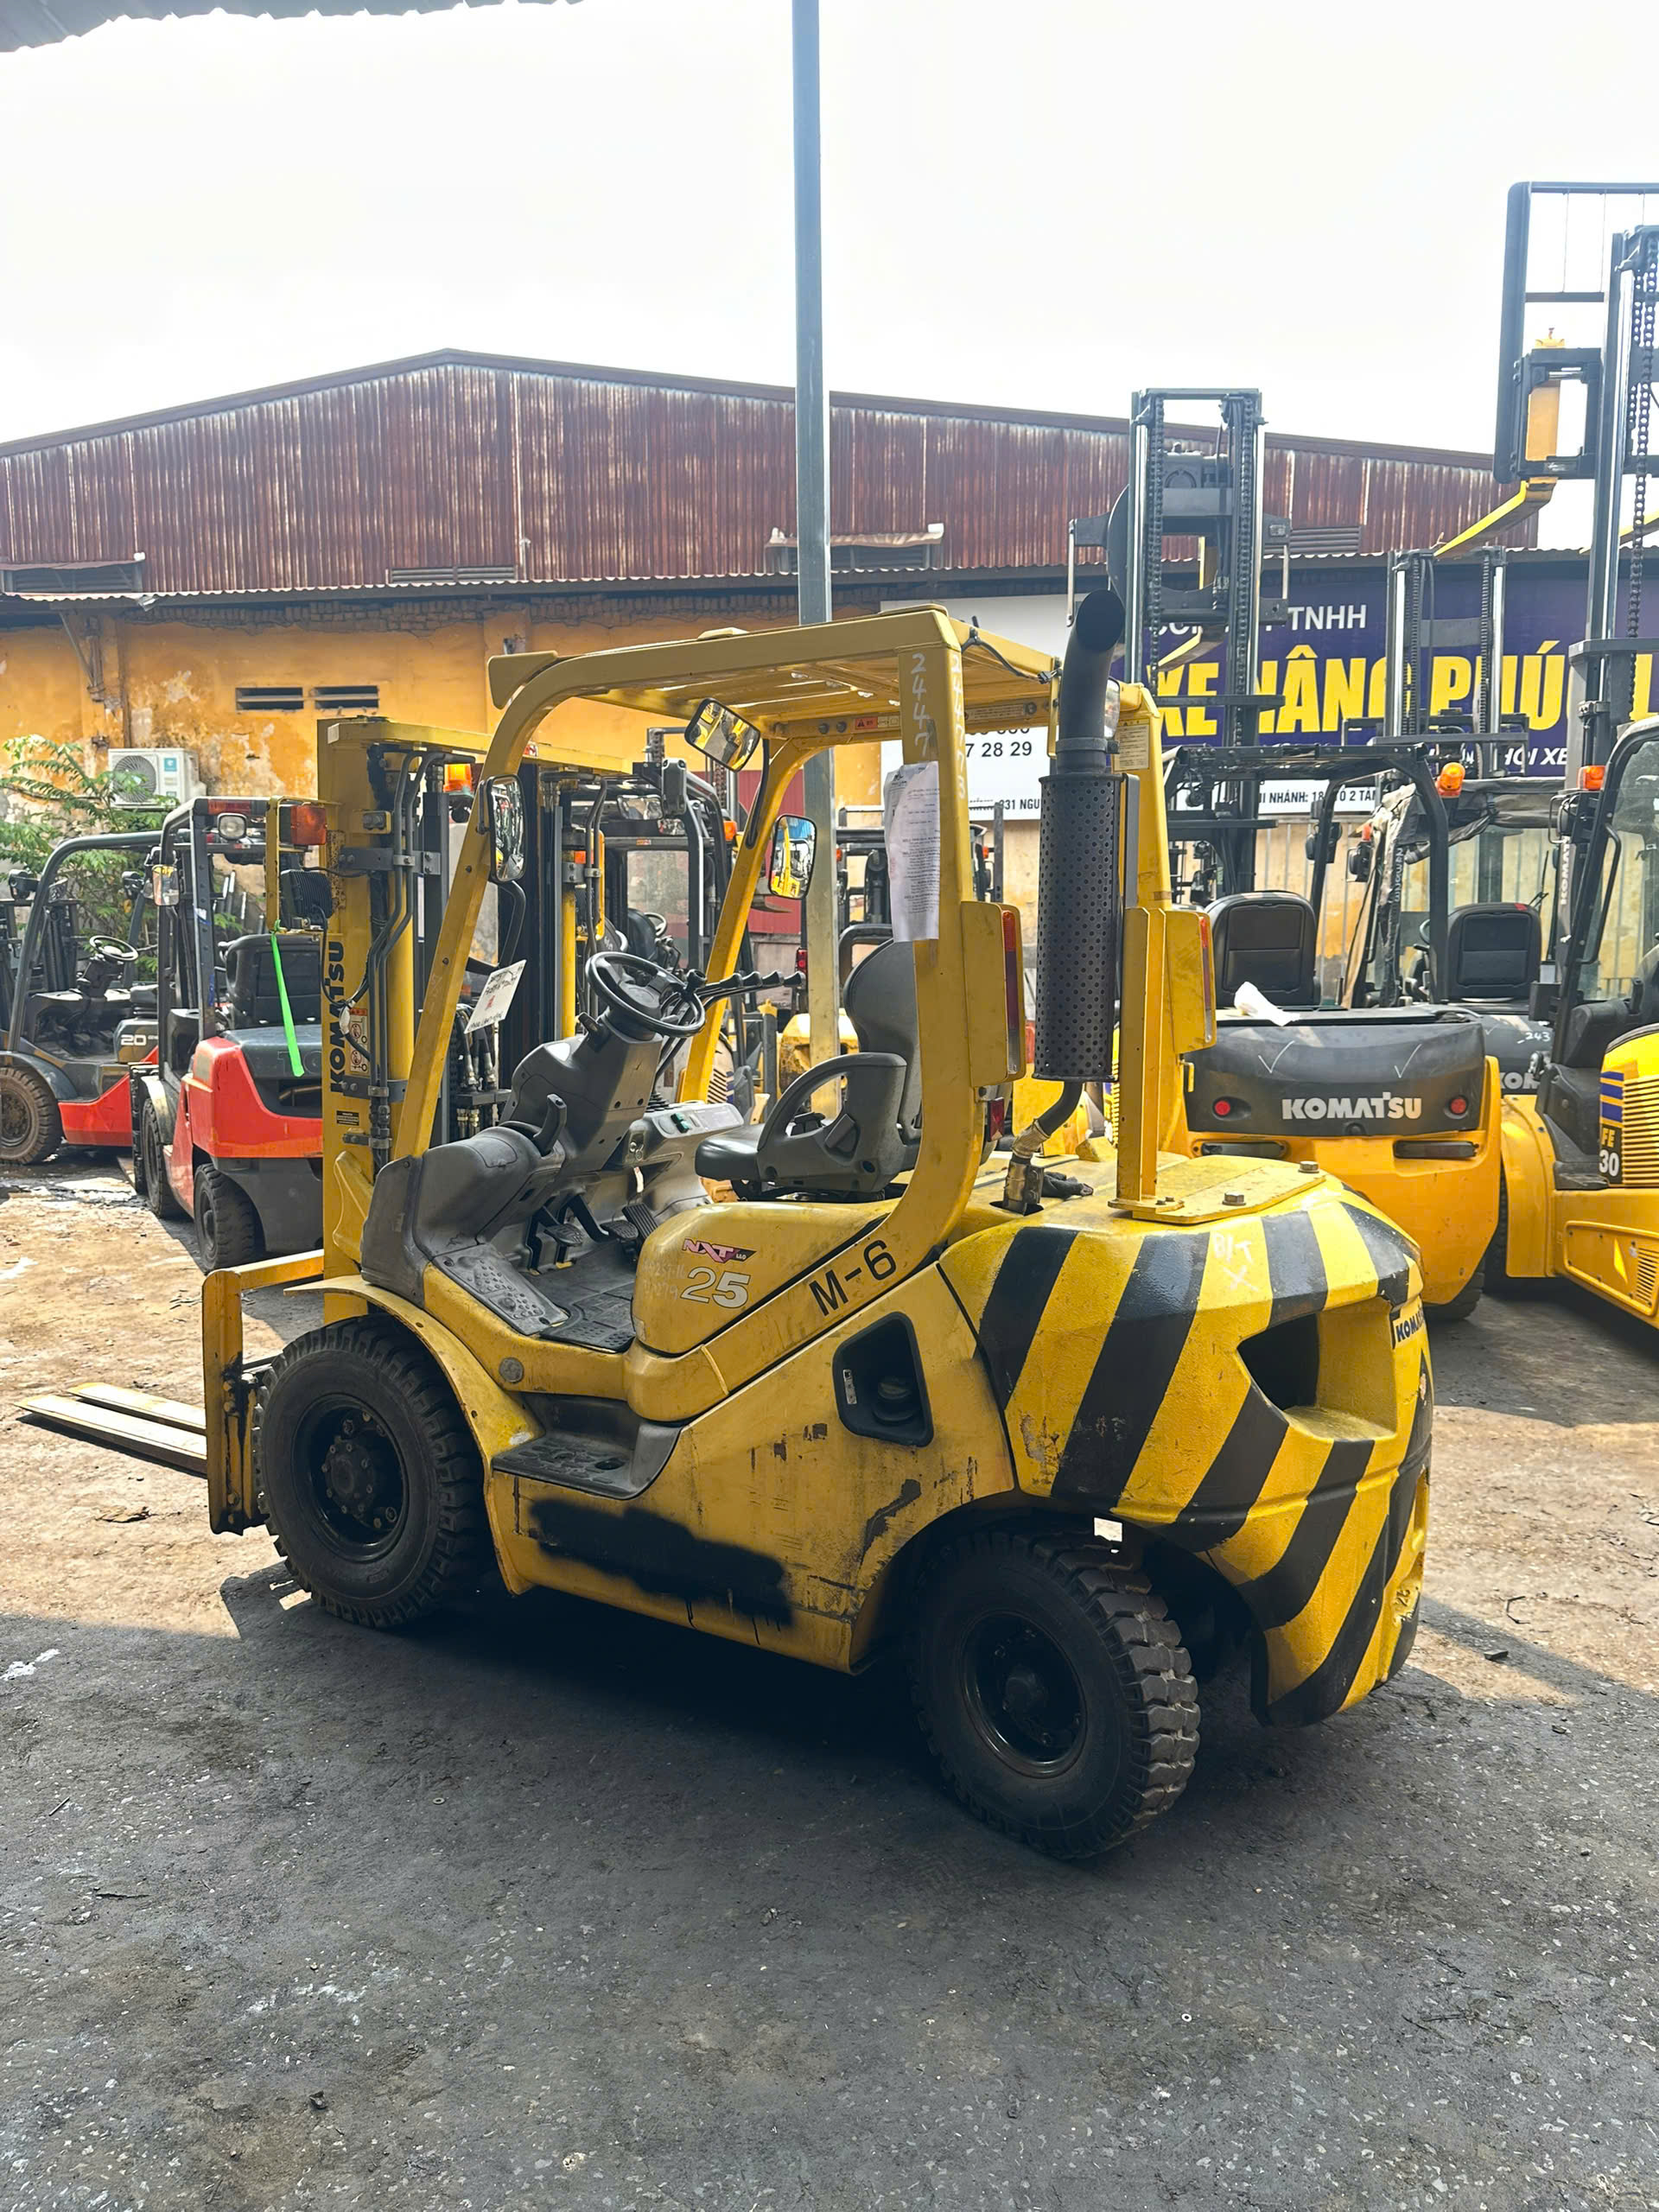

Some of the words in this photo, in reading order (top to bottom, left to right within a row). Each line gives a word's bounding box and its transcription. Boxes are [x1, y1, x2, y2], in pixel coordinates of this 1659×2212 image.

[1287, 605, 1367, 631] TNHH
[1429, 640, 1571, 731] PHÚ
[982, 742, 1003, 757] 28
[1010, 741, 1032, 756] 29
[1269, 789, 1308, 804] NHÁNH:
[1350, 791, 1356, 801] 2
[325, 941, 346, 1093] KOMATSU
[121, 1034, 147, 1046] 20
[1281, 1091, 1422, 1120] KOMATSU
[1601, 1128, 1615, 1147] FE
[1599, 1149, 1619, 1176] 30
[682, 1238, 734, 1263] NXT
[679, 1266, 752, 1309] 25
[809, 1239, 897, 1316] M-6
